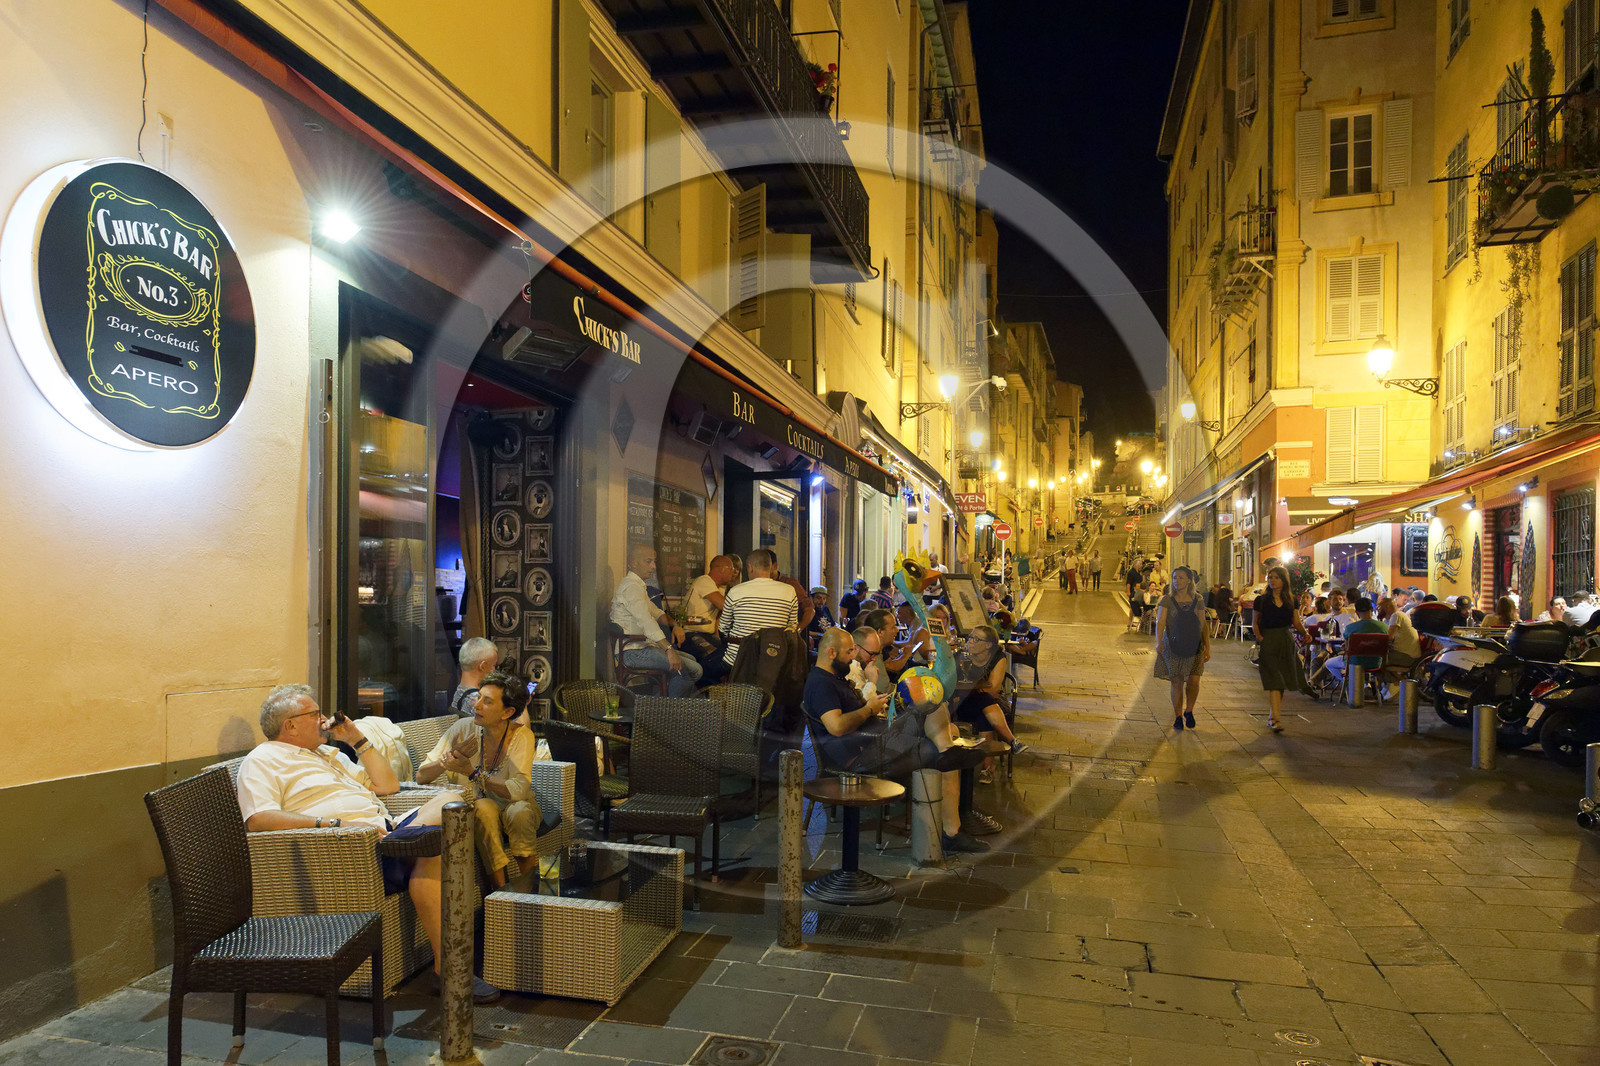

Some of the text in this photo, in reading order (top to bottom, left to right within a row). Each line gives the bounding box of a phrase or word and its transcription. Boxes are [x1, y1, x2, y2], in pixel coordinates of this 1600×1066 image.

[97, 208, 213, 280] CHICK'S BAR
[107, 316, 200, 353] Bar, Cocktails
[621, 331, 641, 364] BAR
[110, 363, 199, 395] APERO
[732, 391, 755, 424] BAR
[787, 424, 825, 460] COCKTAILS
